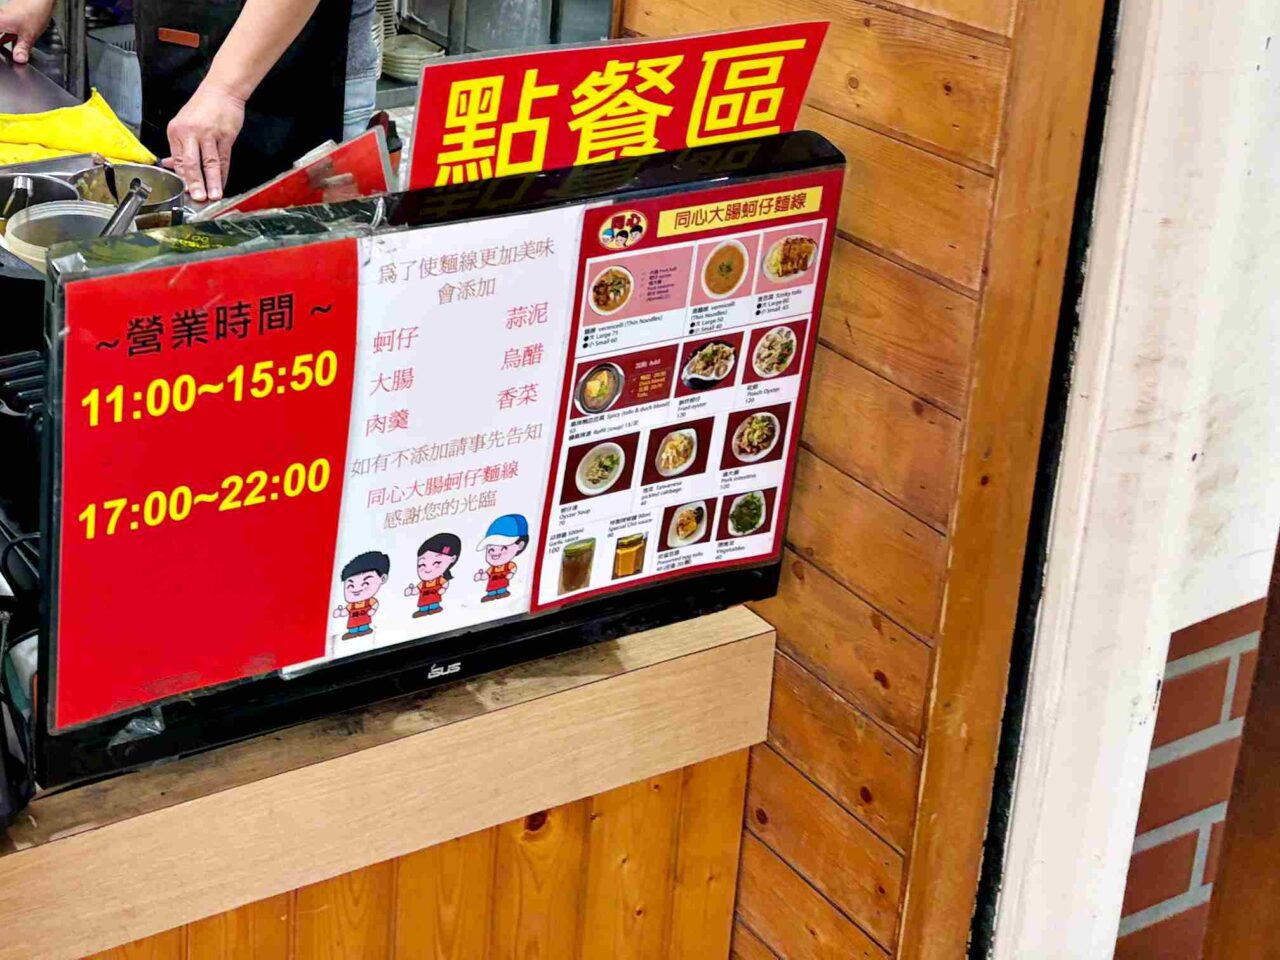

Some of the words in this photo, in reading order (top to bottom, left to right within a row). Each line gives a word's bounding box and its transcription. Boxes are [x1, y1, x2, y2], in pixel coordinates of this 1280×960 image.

[435, 38, 807, 187] 點餐區
[674, 192, 807, 230] 同心大腸蚵仔麵線
[436, 277, 496, 306] 會添加
[505, 302, 549, 330] 蒜泥
[373, 327, 420, 354] 蚵仔
[500, 343, 544, 371] 烏醋
[81, 350, 339, 427] 11:00~15:50
[369, 368, 415, 396] 大腸
[496, 383, 539, 411] 香菜
[365, 409, 410, 437] 肉羹
[350, 423, 543, 479] 如有不添加請事先告知
[77, 458, 331, 540] 17:00~22:00
[366, 460, 519, 509] 同心大腸蚵仔麵線
[382, 489, 497, 530] 感謝您的光臨
[427, 662, 462, 680] ASUS
